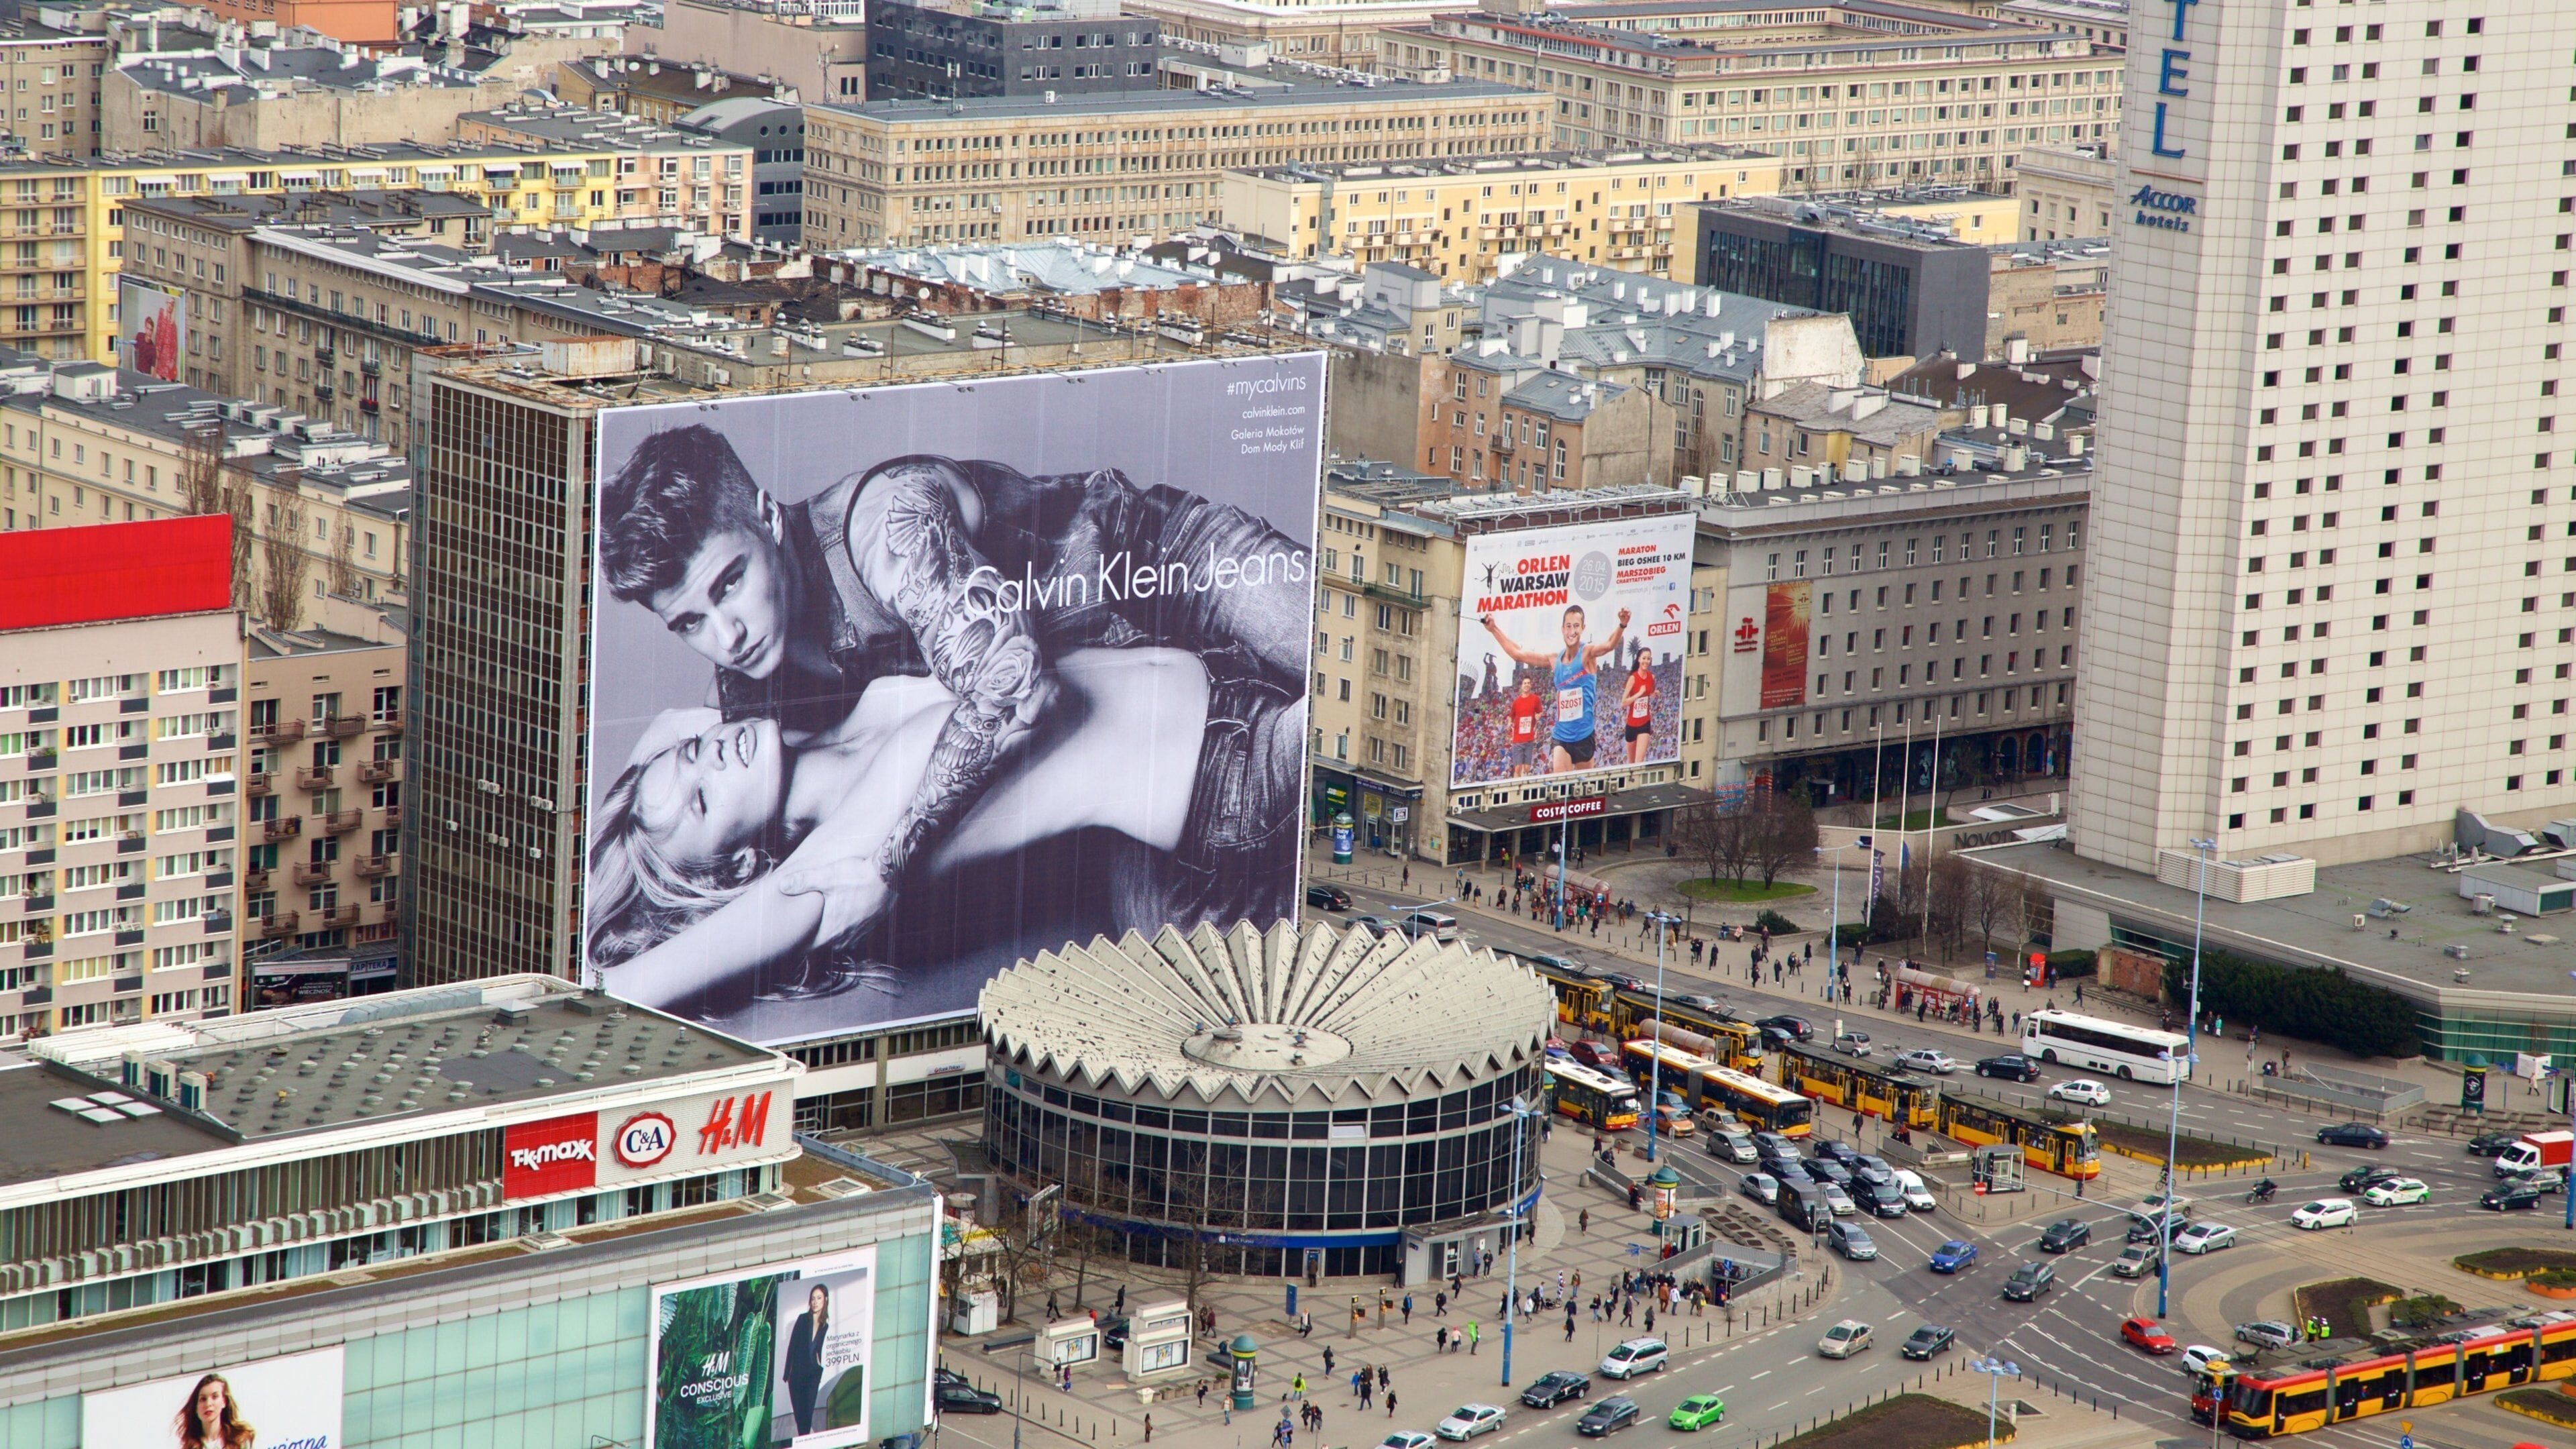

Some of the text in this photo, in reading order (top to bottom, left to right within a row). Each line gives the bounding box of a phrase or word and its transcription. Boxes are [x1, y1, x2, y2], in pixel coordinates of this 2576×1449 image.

[2136, 211, 2189, 232] hotels
[1226, 371, 1306, 400] #mycalvins
[1242, 405, 1305, 419] calvinklein.com
[1231, 425, 1304, 440] Galeria Mokotów
[1242, 438, 1304, 454] Dom Mody Klif
[1618, 545, 1657, 555] MARATON
[1517, 555, 1570, 575] ORLEN
[1617, 552, 1686, 567] BIEG OSHEE 10 KM
[964, 542, 1306, 616] Calvin Klein Jeans
[1617, 566, 1666, 578] MARSZOBIEG
[1500, 572, 1570, 594] WARSAW
[1578, 576, 1605, 594] 2015
[1477, 589, 1568, 613] MARATHON
[1650, 623, 1679, 635] ORLEN
[1560, 698, 1582, 709] SZOST
[1537, 801, 1601, 818] COSTA COFFEE
[1953, 825, 2023, 851] NOVOT
[699, 1090, 772, 1155] H&M
[626, 1126, 665, 1155] C&A
[826, 1332, 855, 1342] Marynarka
[826, 1338, 861, 1350] organicznego
[702, 1350, 730, 1377] H&M
[826, 1353, 859, 1367] 399 PLN
[680, 1373, 749, 1398] CONSCIOUS
[696, 1391, 732, 1405] EXCLUSIVE
